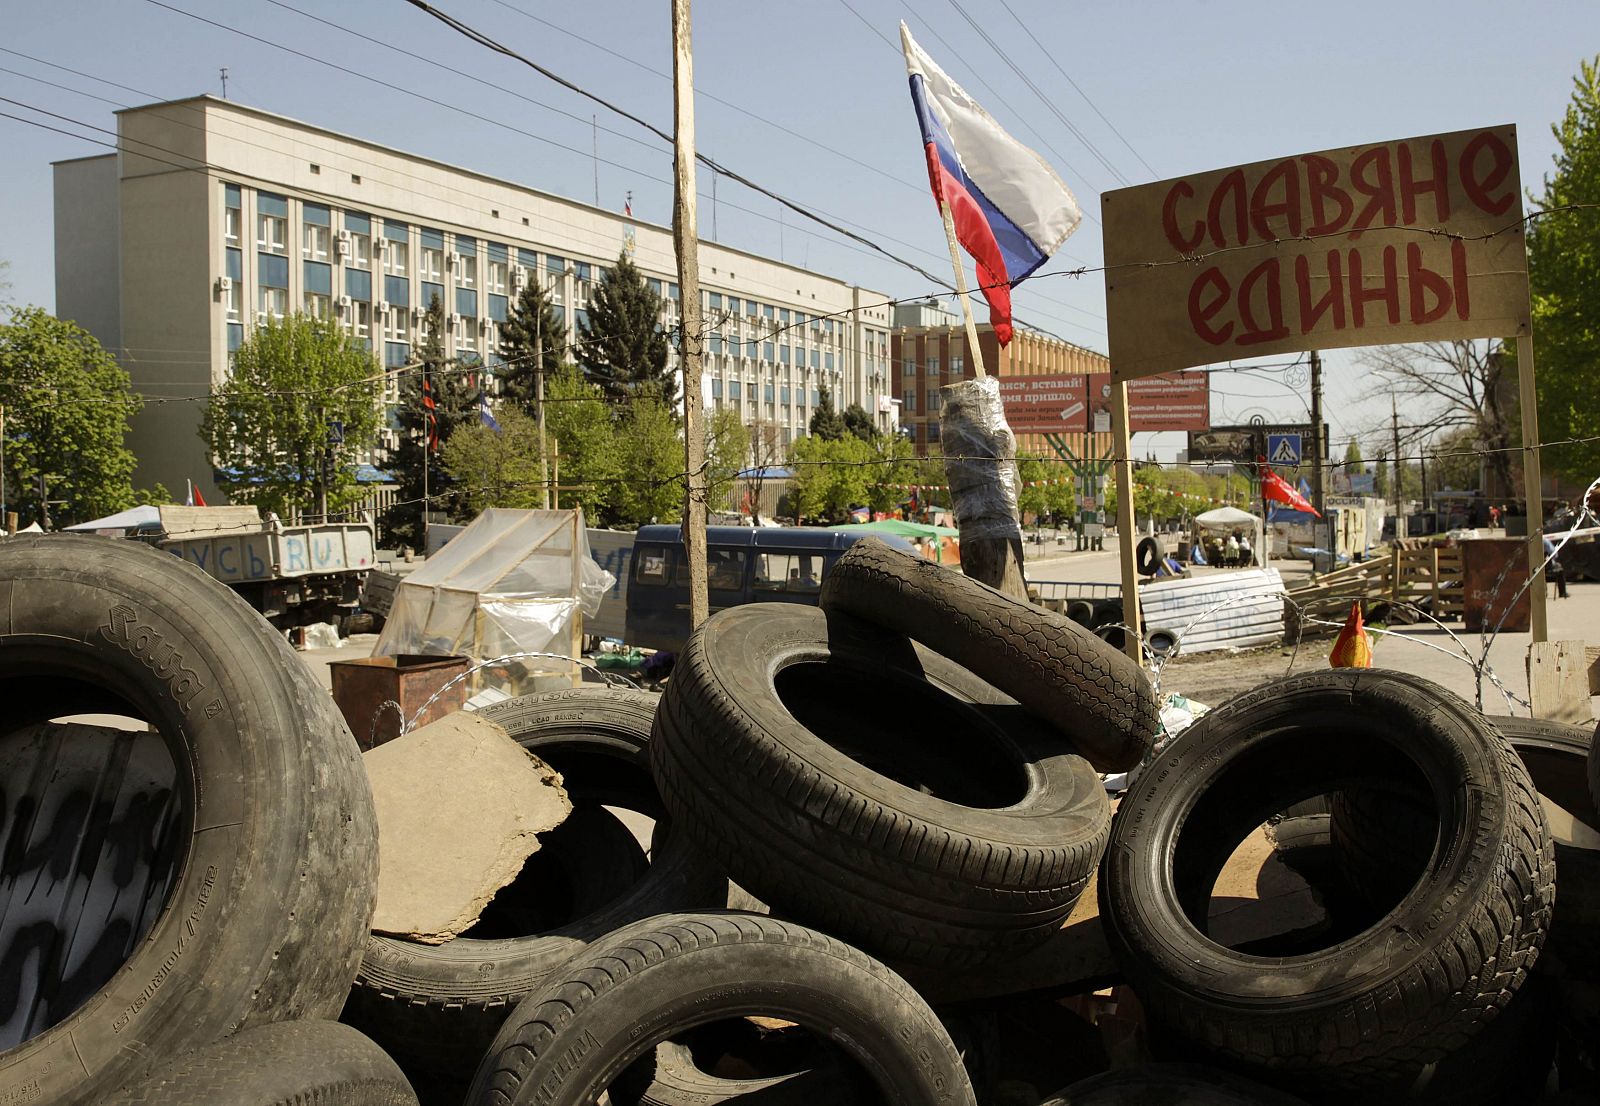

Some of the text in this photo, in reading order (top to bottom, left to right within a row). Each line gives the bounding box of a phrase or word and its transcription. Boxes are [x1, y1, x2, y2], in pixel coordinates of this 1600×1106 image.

[999, 377, 1083, 392] анск, вставай!
[1001, 392, 1076, 405] емя пришло.
[1326, 497, 1364, 506] ОССИЯ
[99, 604, 207, 714] Sava
